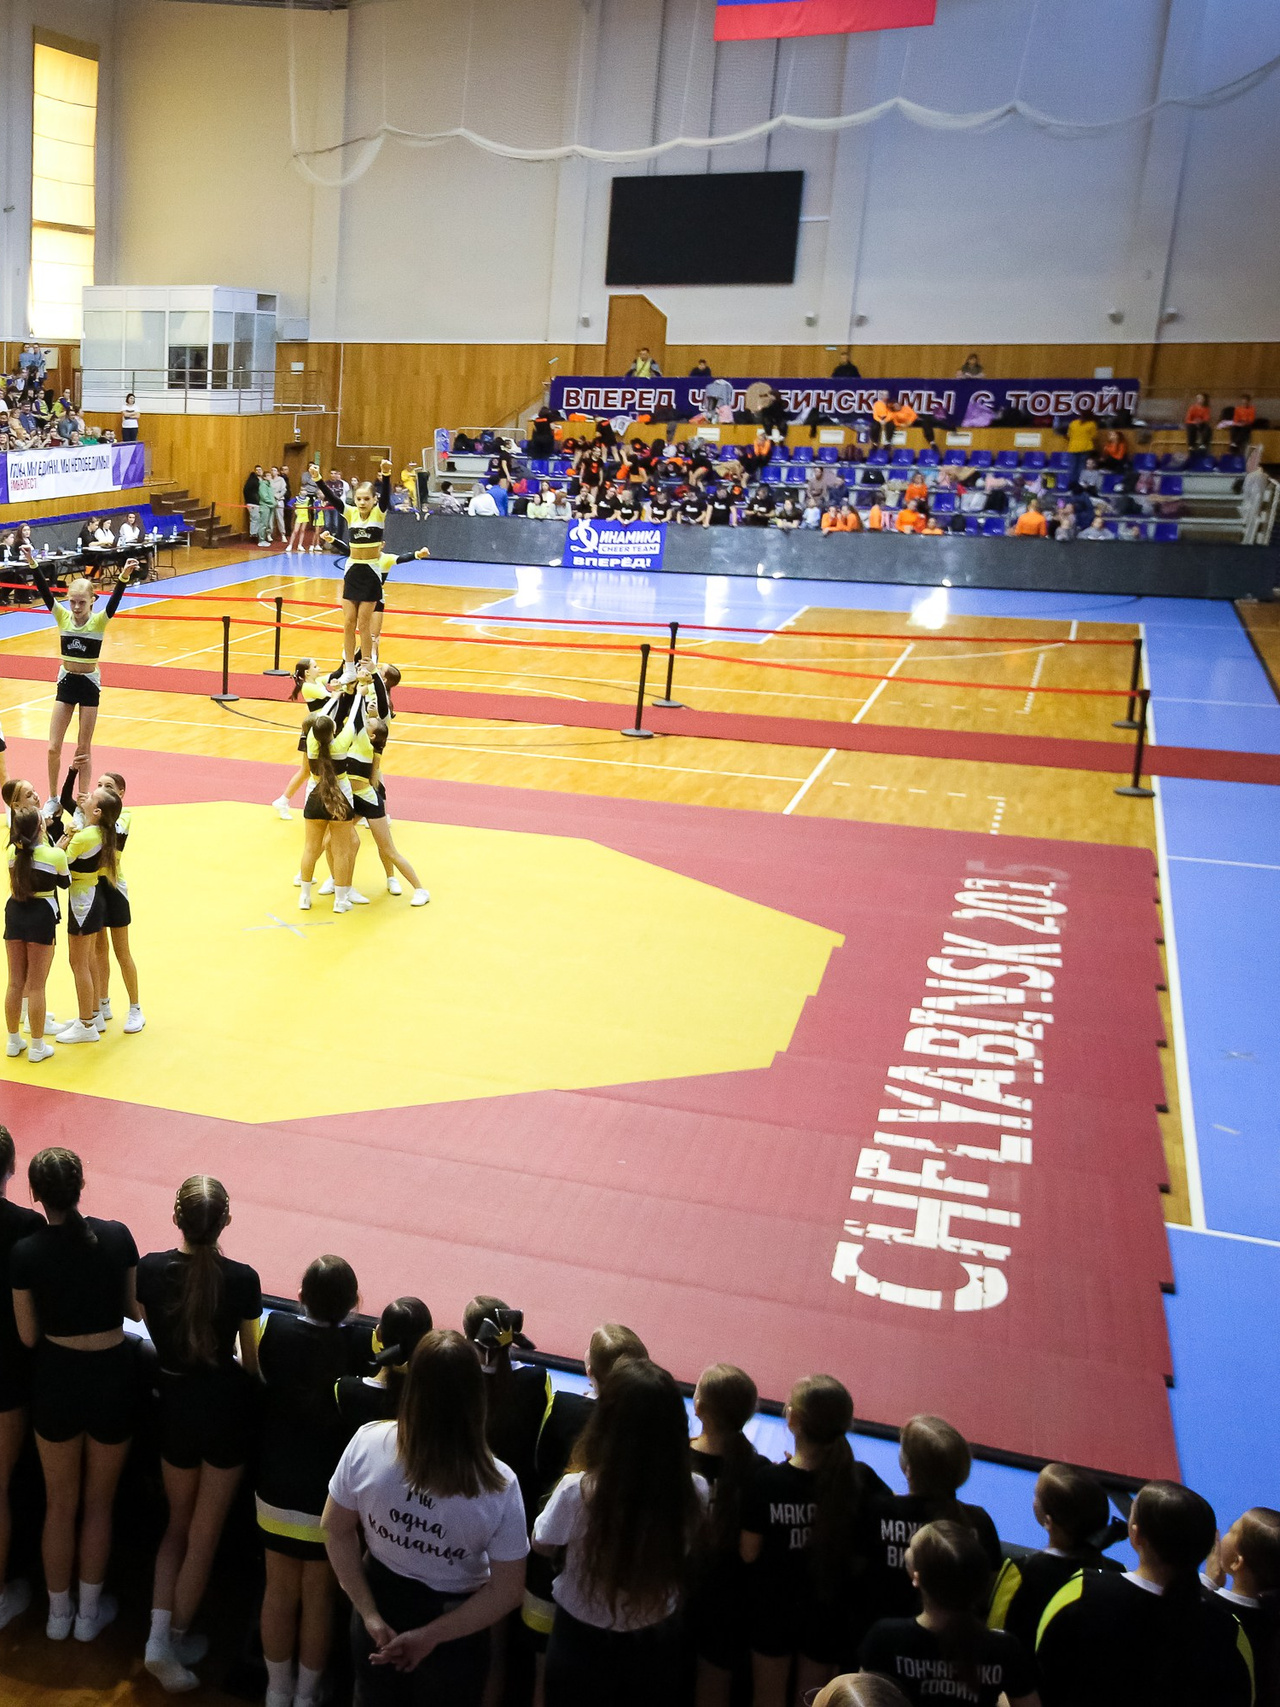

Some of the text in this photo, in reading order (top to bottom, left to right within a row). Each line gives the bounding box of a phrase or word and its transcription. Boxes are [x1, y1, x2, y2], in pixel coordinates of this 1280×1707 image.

[562, 387, 675, 413] ВПЕРЕД
[572, 556, 651, 568] ВПЕРЁД!
[633, 545, 657, 553] TEAM
[831, 931, 1063, 1312] CHELYABINSK
[389, 1508, 447, 1539] одна
[368, 1513, 470, 1566] команда
